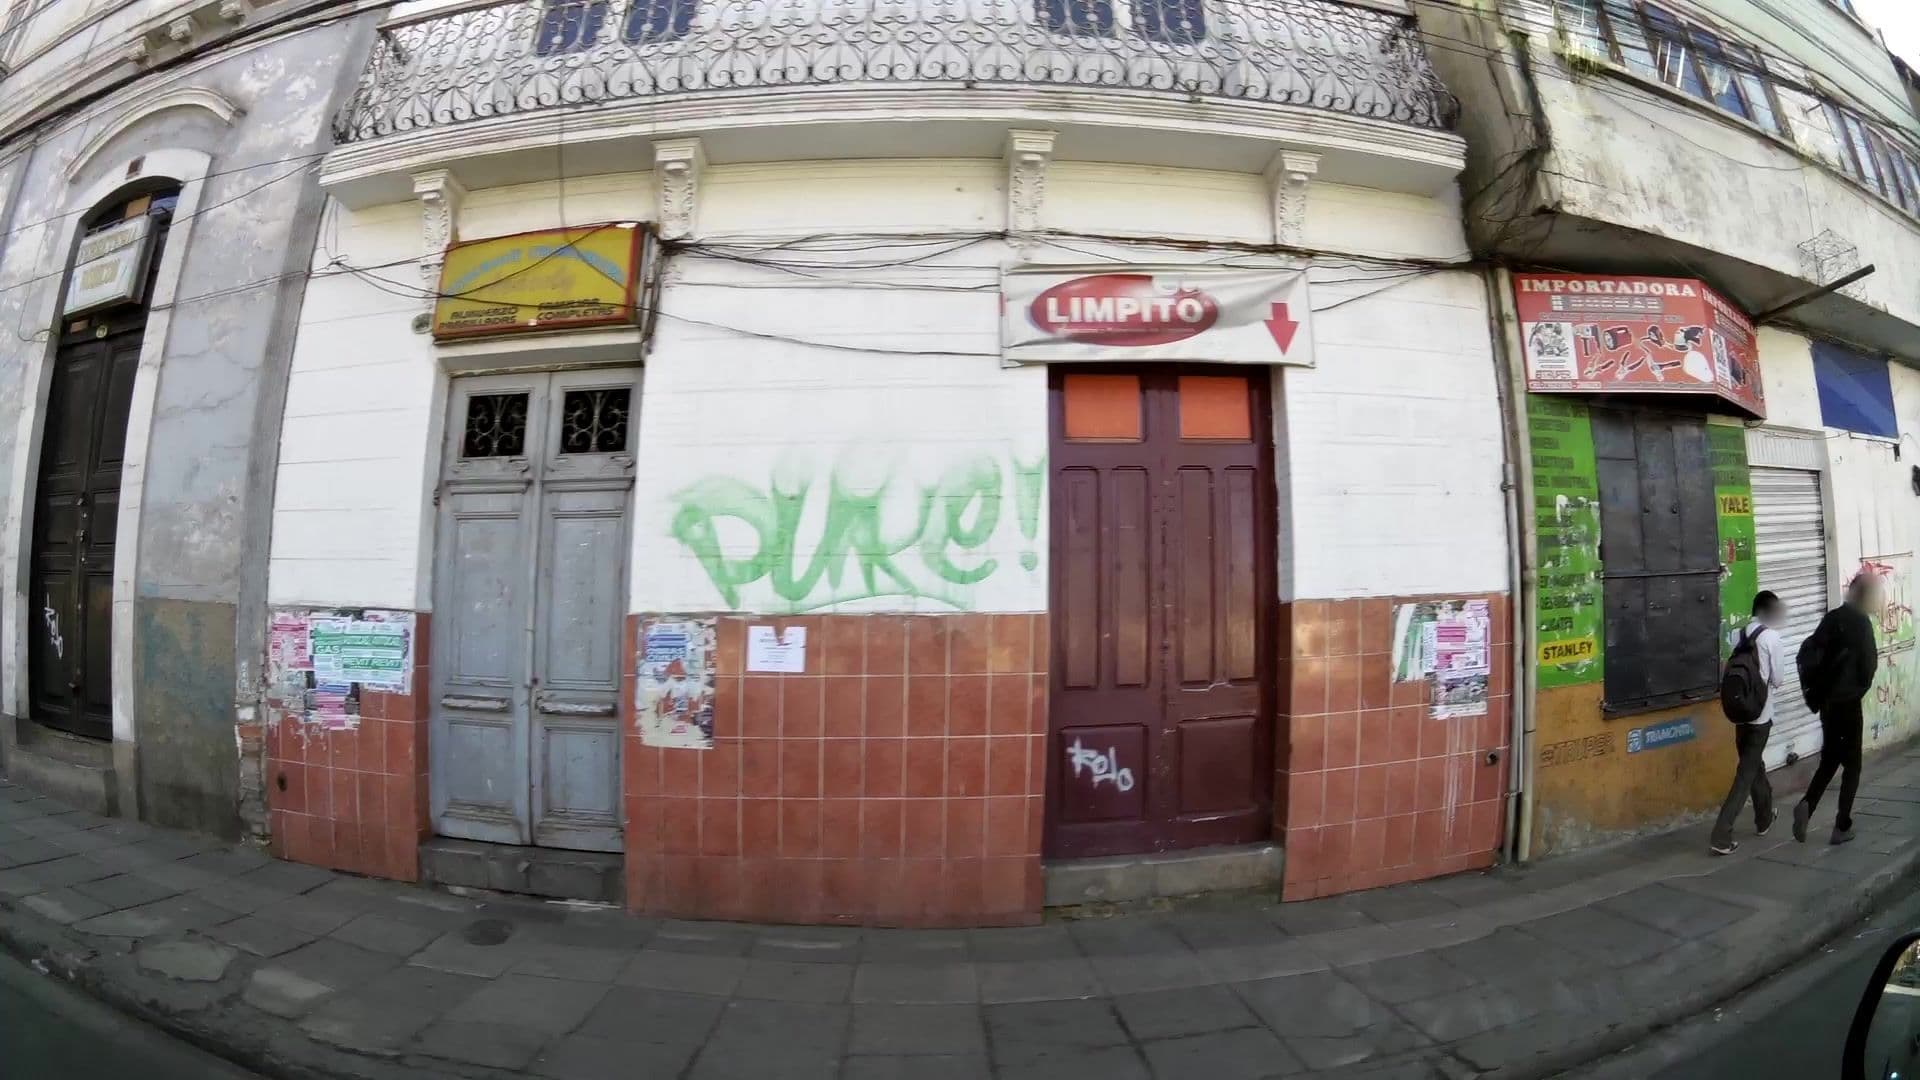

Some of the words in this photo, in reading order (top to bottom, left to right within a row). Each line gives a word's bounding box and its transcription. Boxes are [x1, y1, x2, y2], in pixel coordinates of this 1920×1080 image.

[1520, 279, 1697, 297] IMPORTADORA
[1046, 297, 1203, 324] LIMPITO
[1719, 496, 1750, 514] YALE
[1543, 641, 1593, 661] STANLEY
